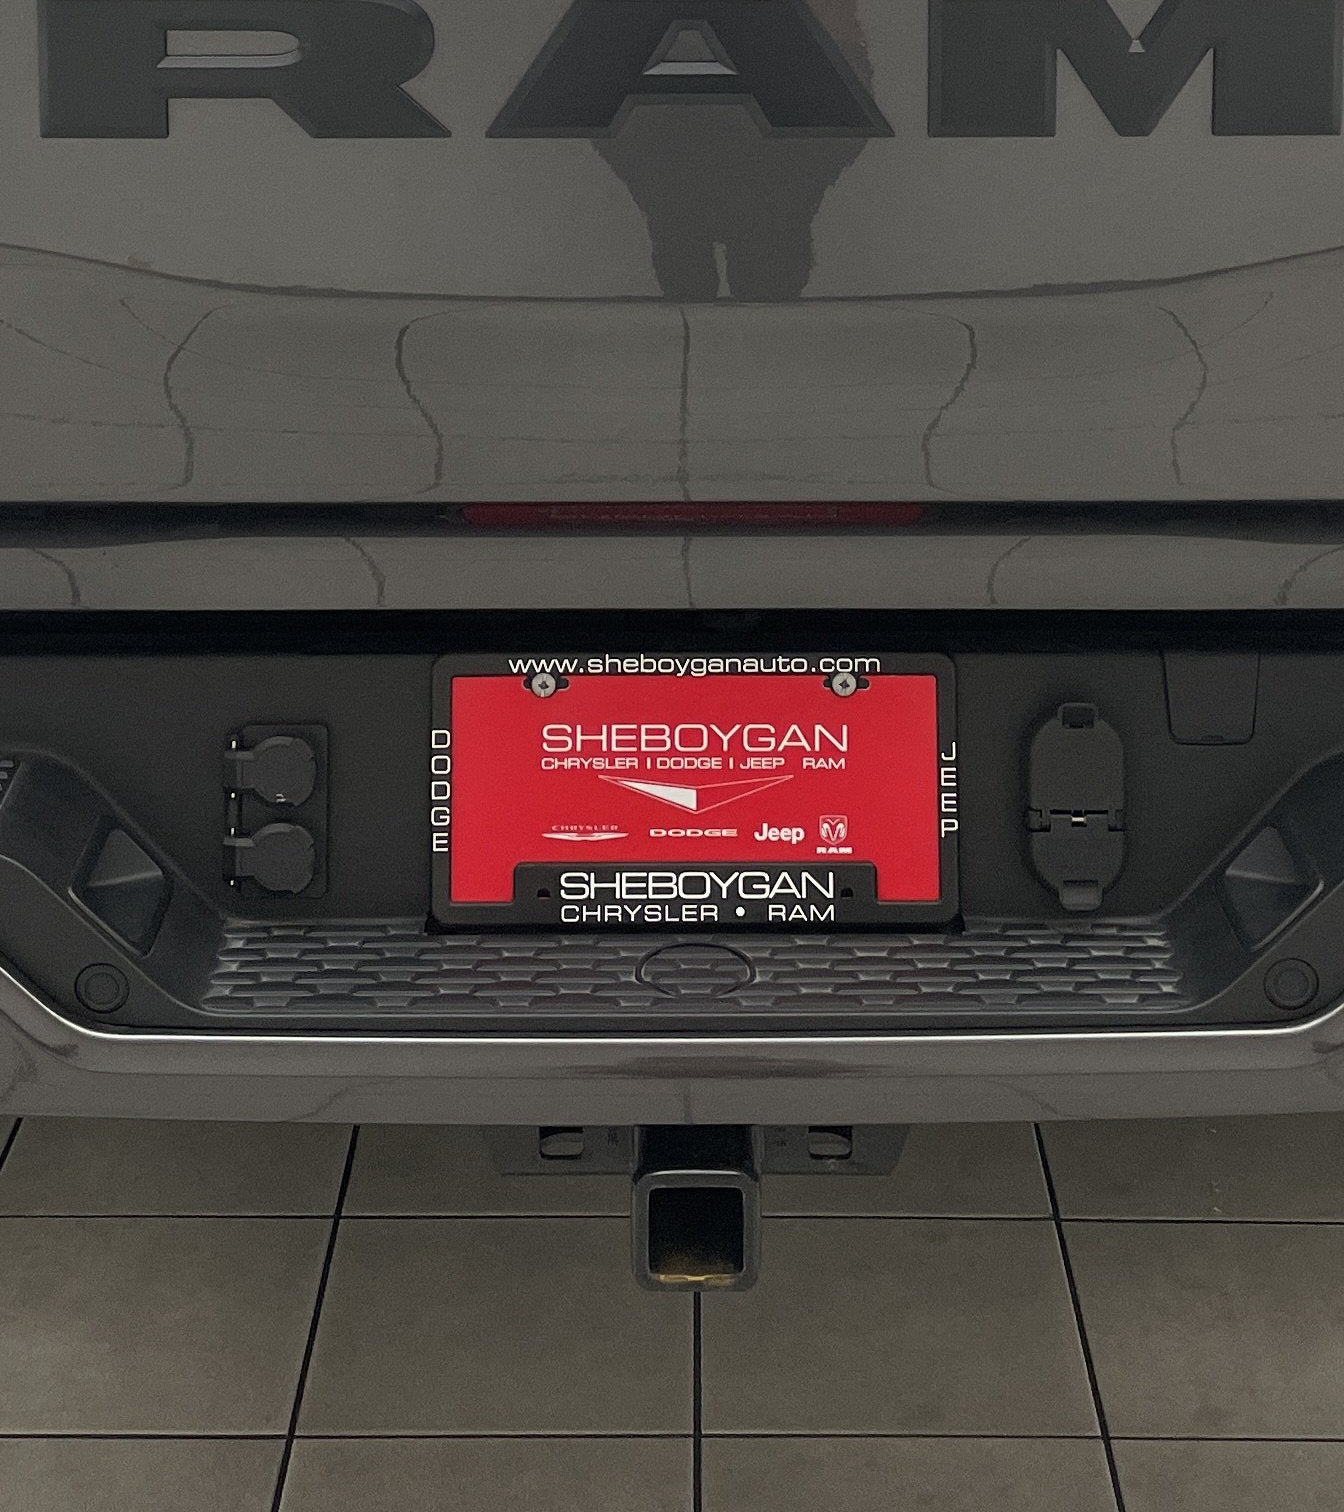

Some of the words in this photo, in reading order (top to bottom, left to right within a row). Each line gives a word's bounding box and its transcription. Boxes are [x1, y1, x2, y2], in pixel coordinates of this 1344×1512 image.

[508, 654, 882, 677] www.sheboyganauto.com
[541, 724, 849, 753] SHEBOYGAN
[541, 756, 639, 770] CHRYSLER
[656, 756, 723, 770] DODGE
[739, 756, 785, 770] JEEP
[802, 756, 846, 770] RAM
[430, 728, 451, 853] DODGE
[940, 741, 958, 838] JEEP
[649, 828, 739, 837] DODGE
[753, 822, 806, 845] Jeep
[815, 846, 854, 854] RAM
[559, 871, 835, 900] SHEBOYGAN
[560, 904, 720, 923] CHRYSLER
[768, 904, 837, 923] RAM
